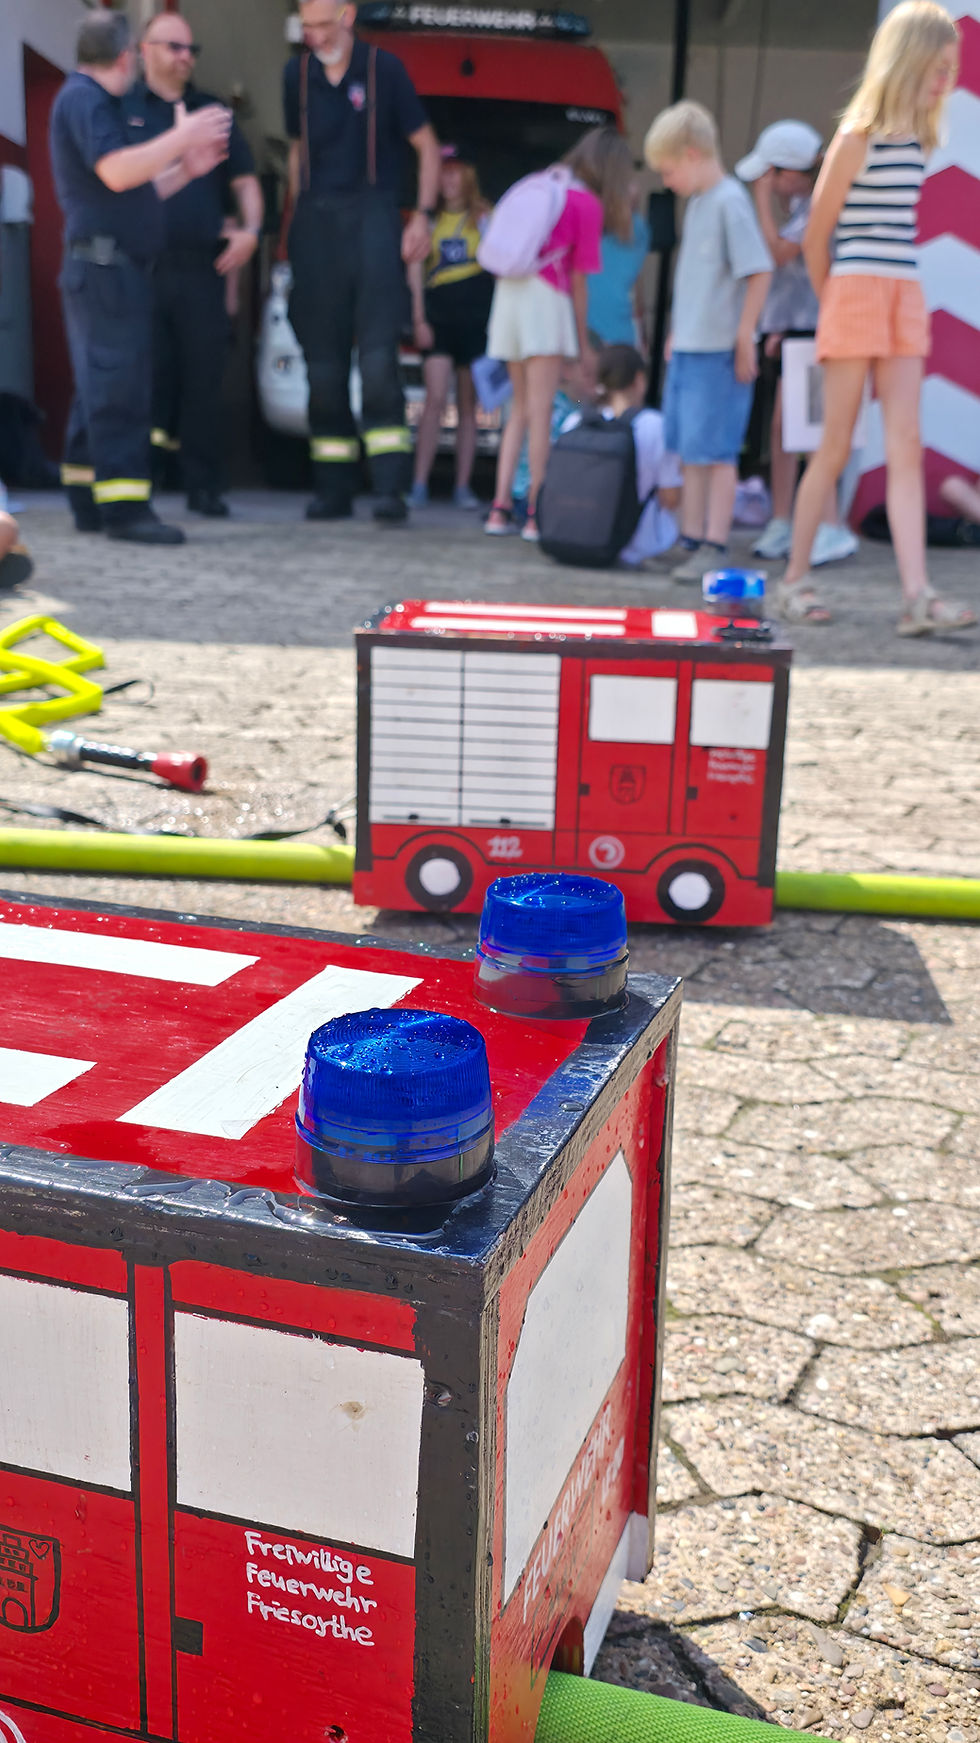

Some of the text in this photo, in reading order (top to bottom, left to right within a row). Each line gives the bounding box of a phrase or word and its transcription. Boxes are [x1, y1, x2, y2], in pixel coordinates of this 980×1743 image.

[408, 5, 536, 30] FEUERWEHR
[487, 835, 523, 858] 112
[522, 1403, 611, 1624] FEUERWEHR
[244, 1530, 374, 1585] Freiwillige
[246, 1562, 377, 1614] Feuerwehr
[246, 1591, 375, 1647] Friesoythe
